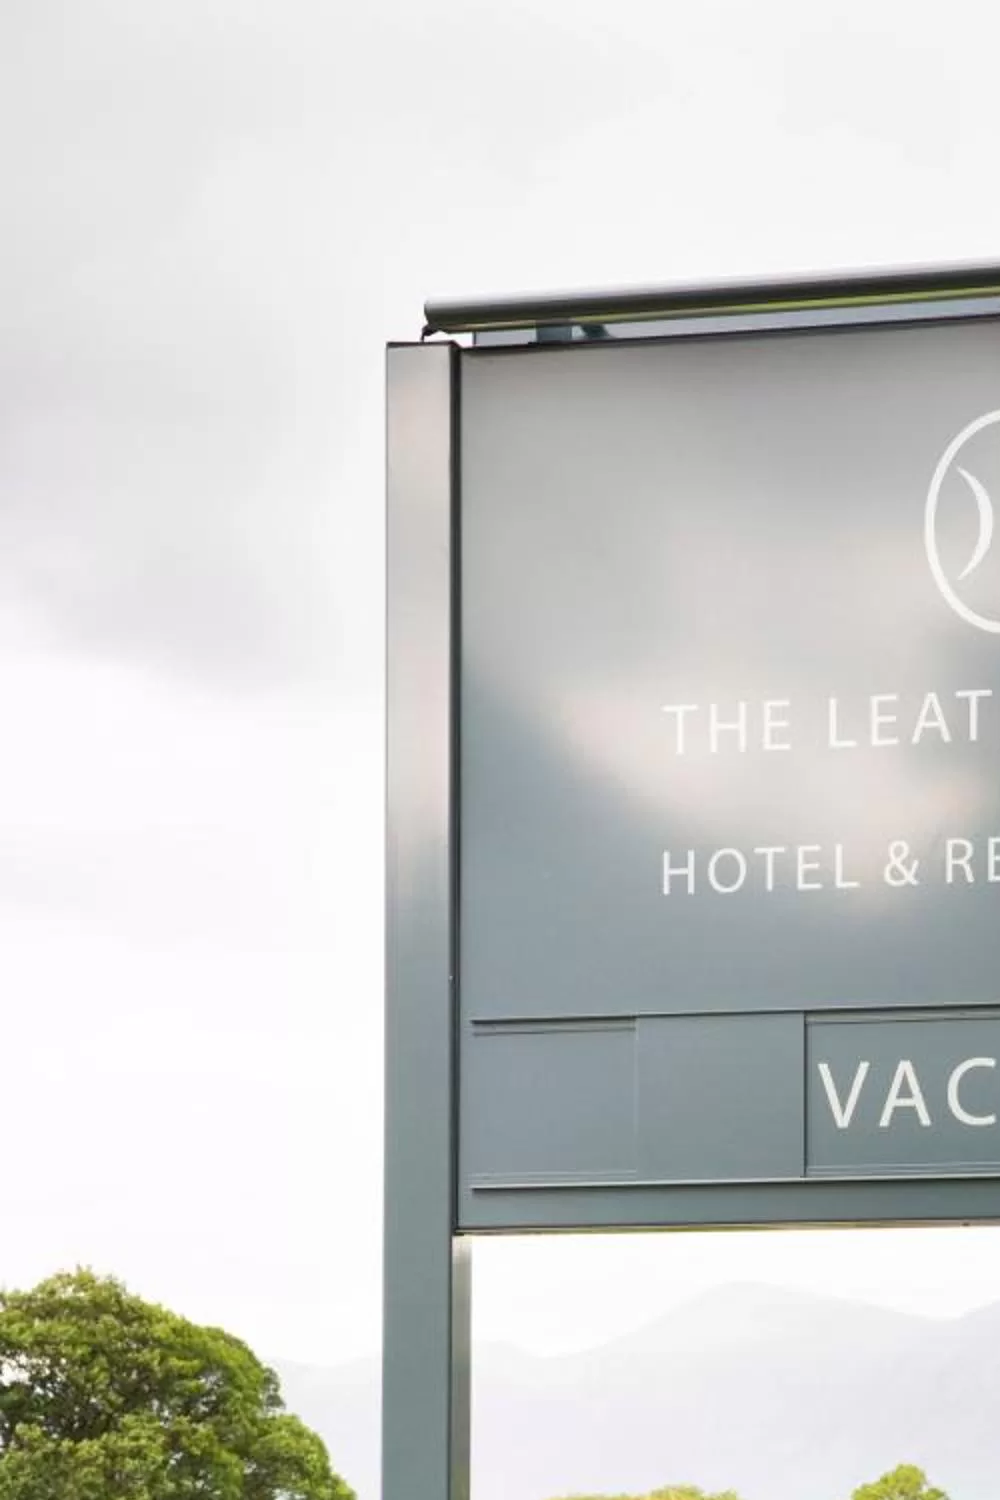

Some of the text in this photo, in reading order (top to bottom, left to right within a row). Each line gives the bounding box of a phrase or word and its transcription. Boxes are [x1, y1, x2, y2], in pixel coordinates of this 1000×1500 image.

[662, 699, 792, 756] THE
[661, 844, 860, 896] HOTEL
[882, 839, 920, 888] &
